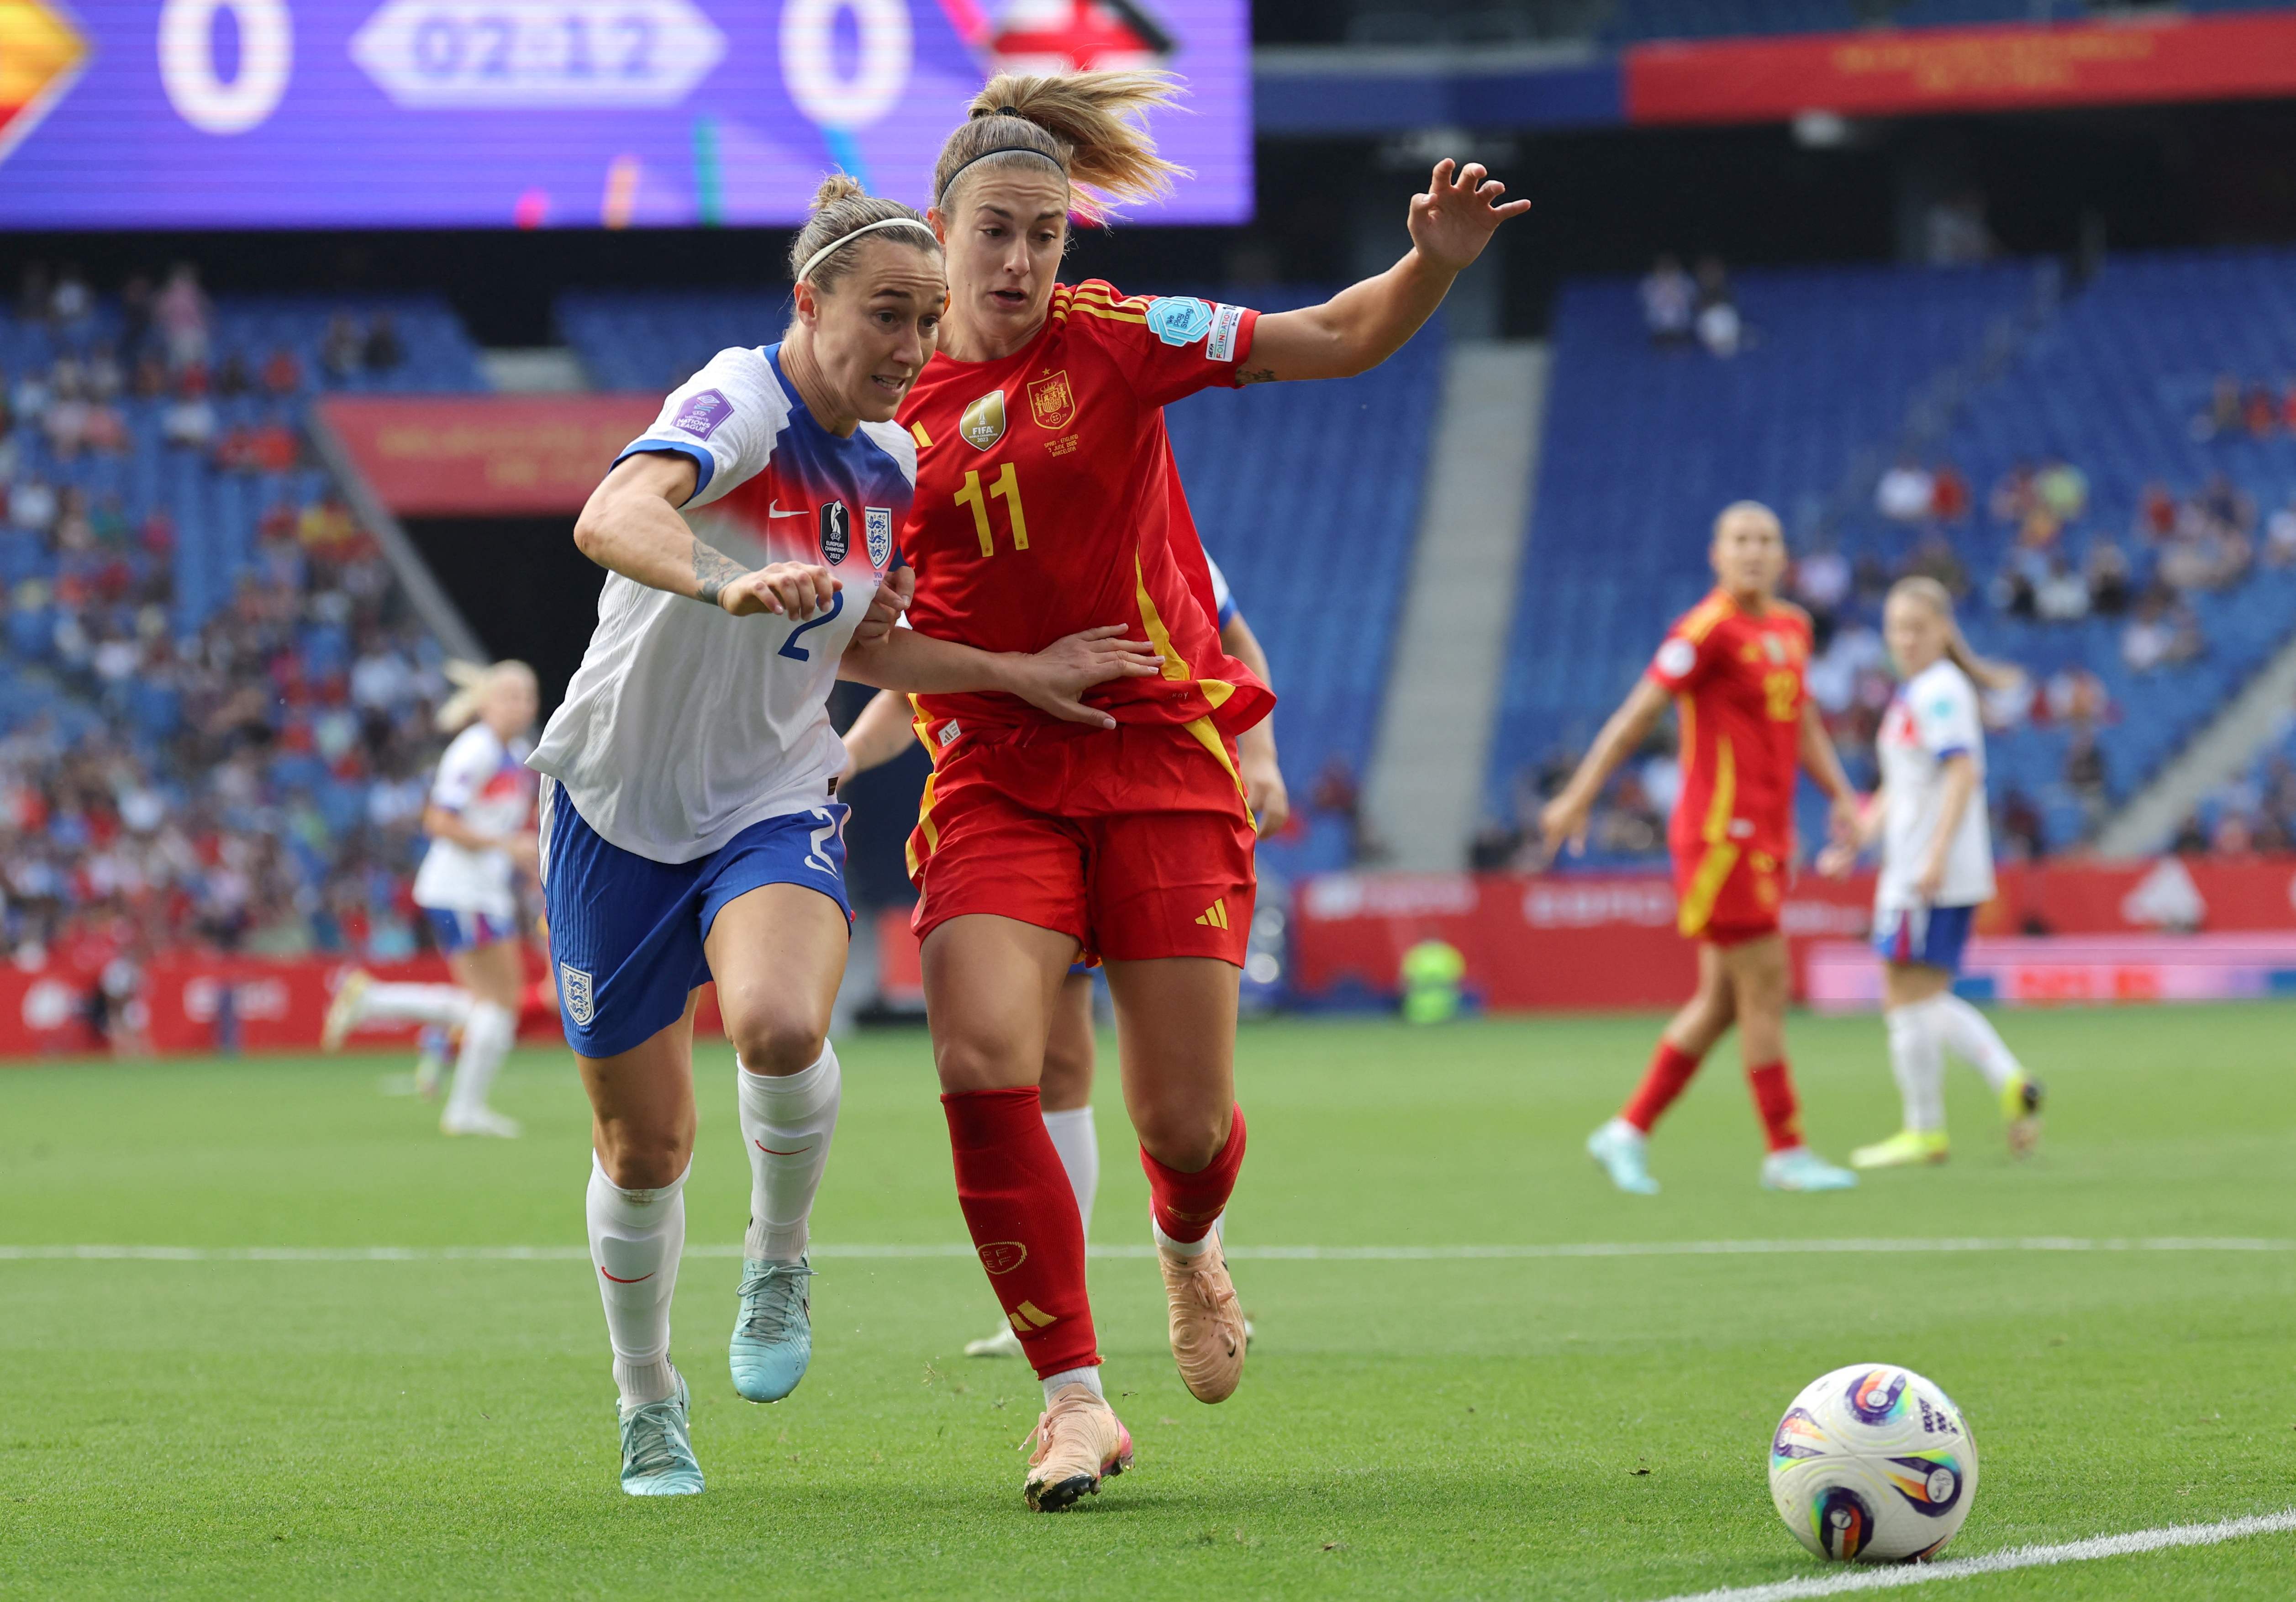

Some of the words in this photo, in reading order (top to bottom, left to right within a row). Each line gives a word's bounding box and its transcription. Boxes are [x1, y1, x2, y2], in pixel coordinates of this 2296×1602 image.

[158, 0, 293, 135] 0
[779, 0, 913, 126] 0
[1166, 315, 1174, 324] We
[1174, 313, 1185, 327] Play
[1181, 308, 1194, 328] Strong
[1216, 311, 1231, 358] FOUNDATION
[676, 422, 706, 433] LEAGUE
[677, 418, 711, 429] NATIONS
[973, 426, 993, 435] FIFA
[1060, 434, 1079, 443] ENGLAND
[1052, 446, 1076, 457] BARCELONA
[954, 462, 1029, 557] 11
[830, 533, 841, 541] UEFA
[778, 590, 843, 662] 2
